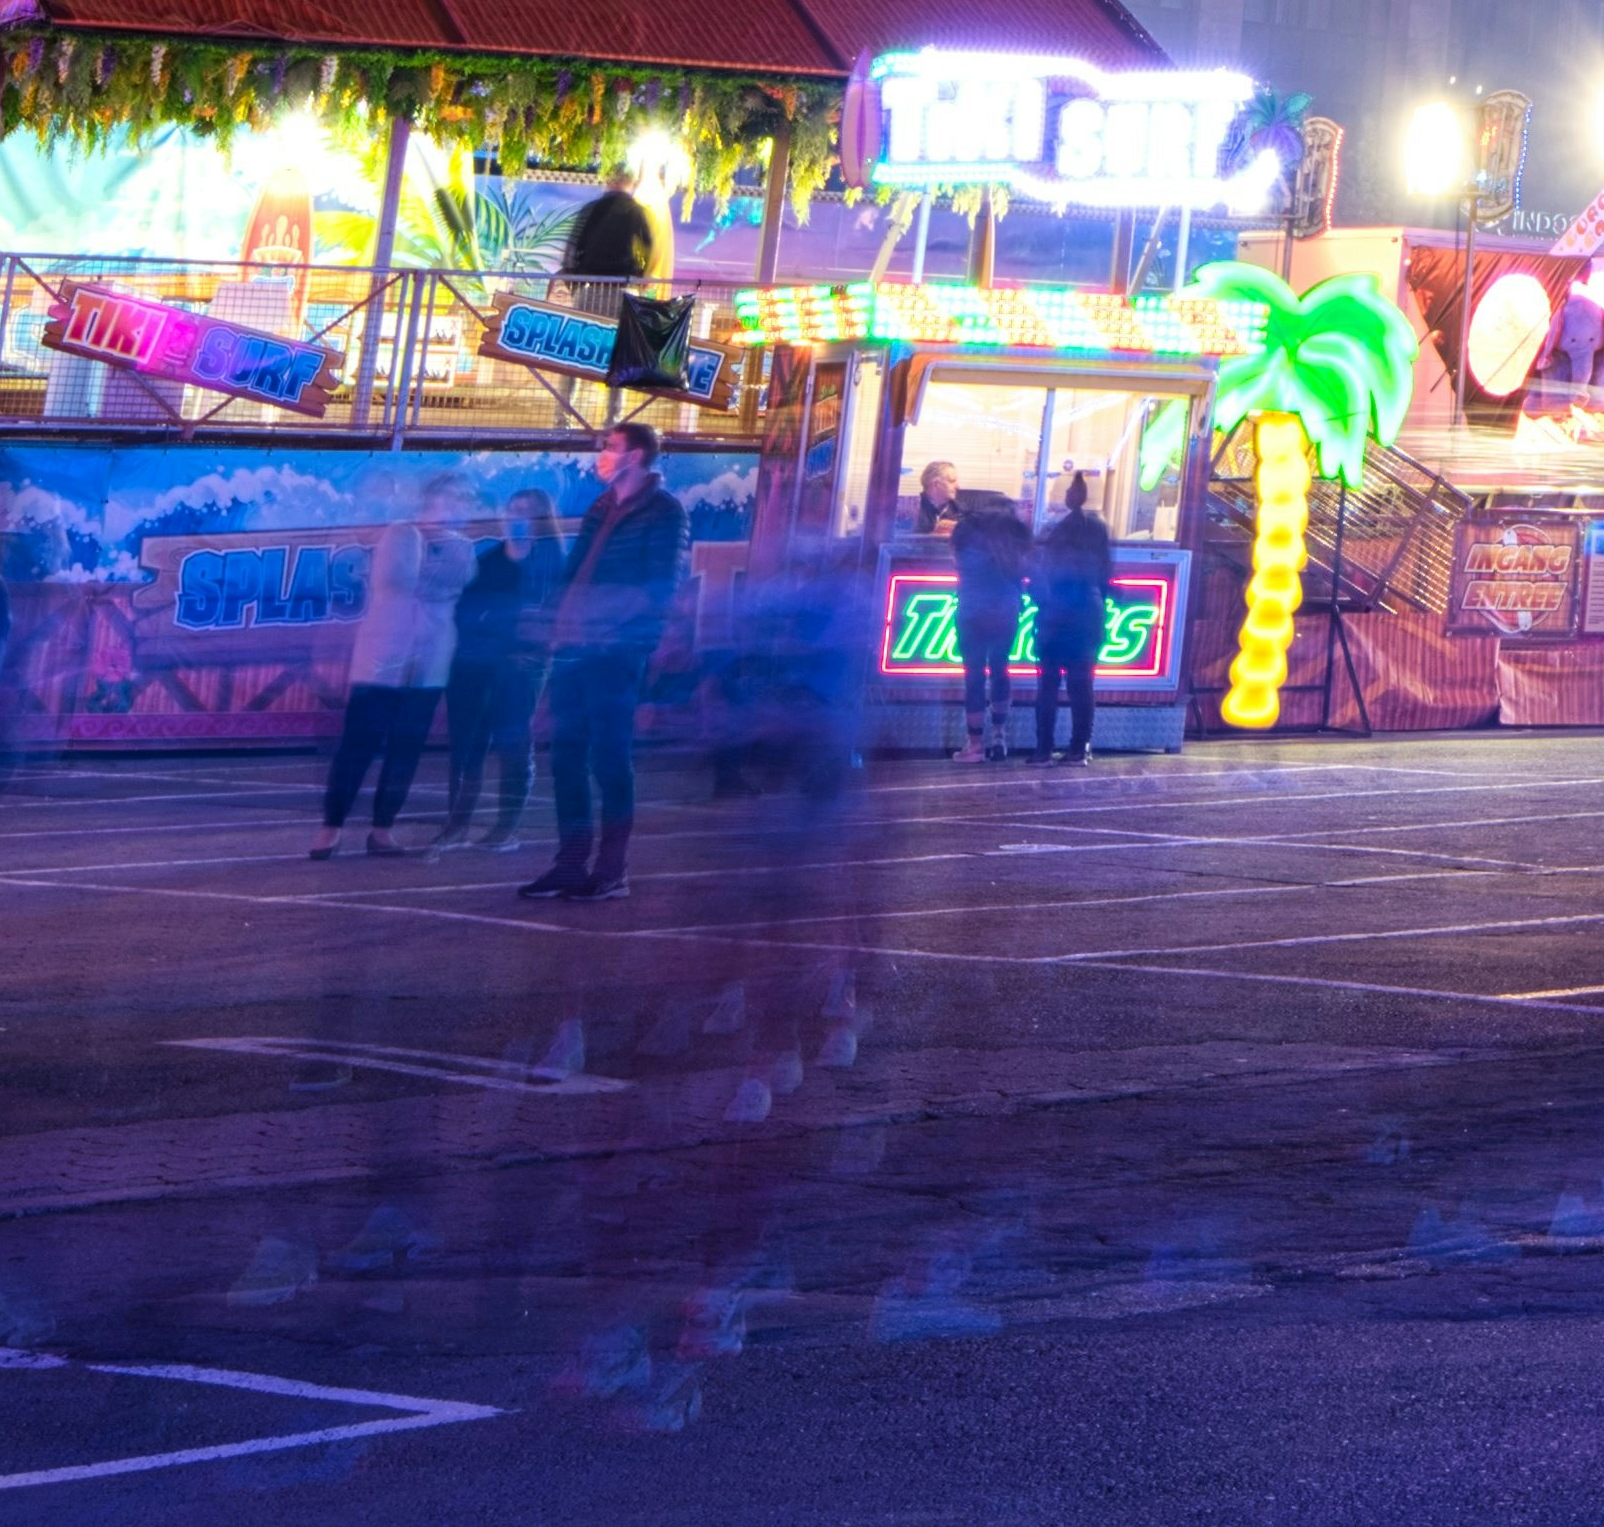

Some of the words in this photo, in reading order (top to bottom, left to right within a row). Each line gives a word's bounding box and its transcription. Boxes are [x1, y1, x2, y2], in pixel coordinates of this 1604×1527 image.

[882, 76, 1050, 162] TIKI
[1057, 97, 1236, 178] SURF
[63, 289, 170, 365] TIKI
[192, 326, 325, 403] SURF
[173, 544, 374, 631] SPLAS
[1462, 581, 1569, 611] ENTREE
[1465, 544, 1572, 574] INGANG
